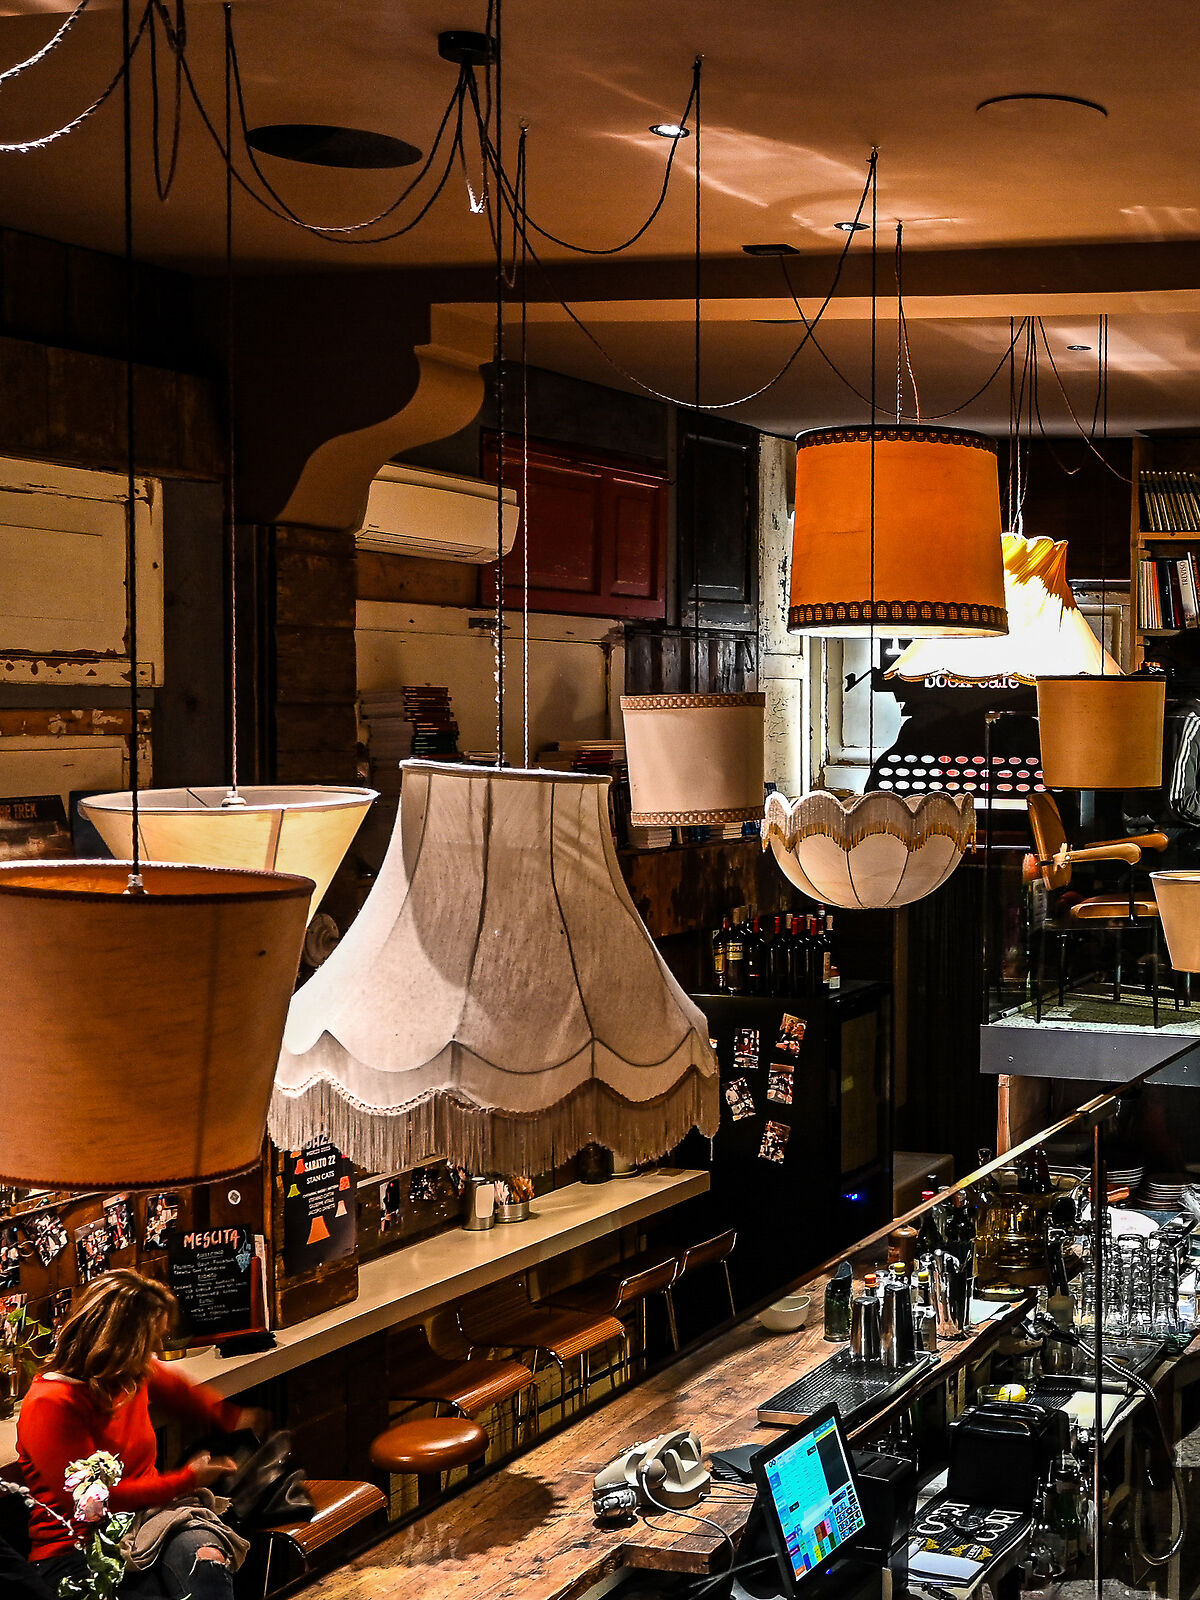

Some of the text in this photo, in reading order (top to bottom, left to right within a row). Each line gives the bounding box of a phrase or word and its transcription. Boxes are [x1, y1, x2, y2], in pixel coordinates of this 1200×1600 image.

[305, 1154, 337, 1172] SABATO 22
[183, 1228, 241, 1250] MESCITA
